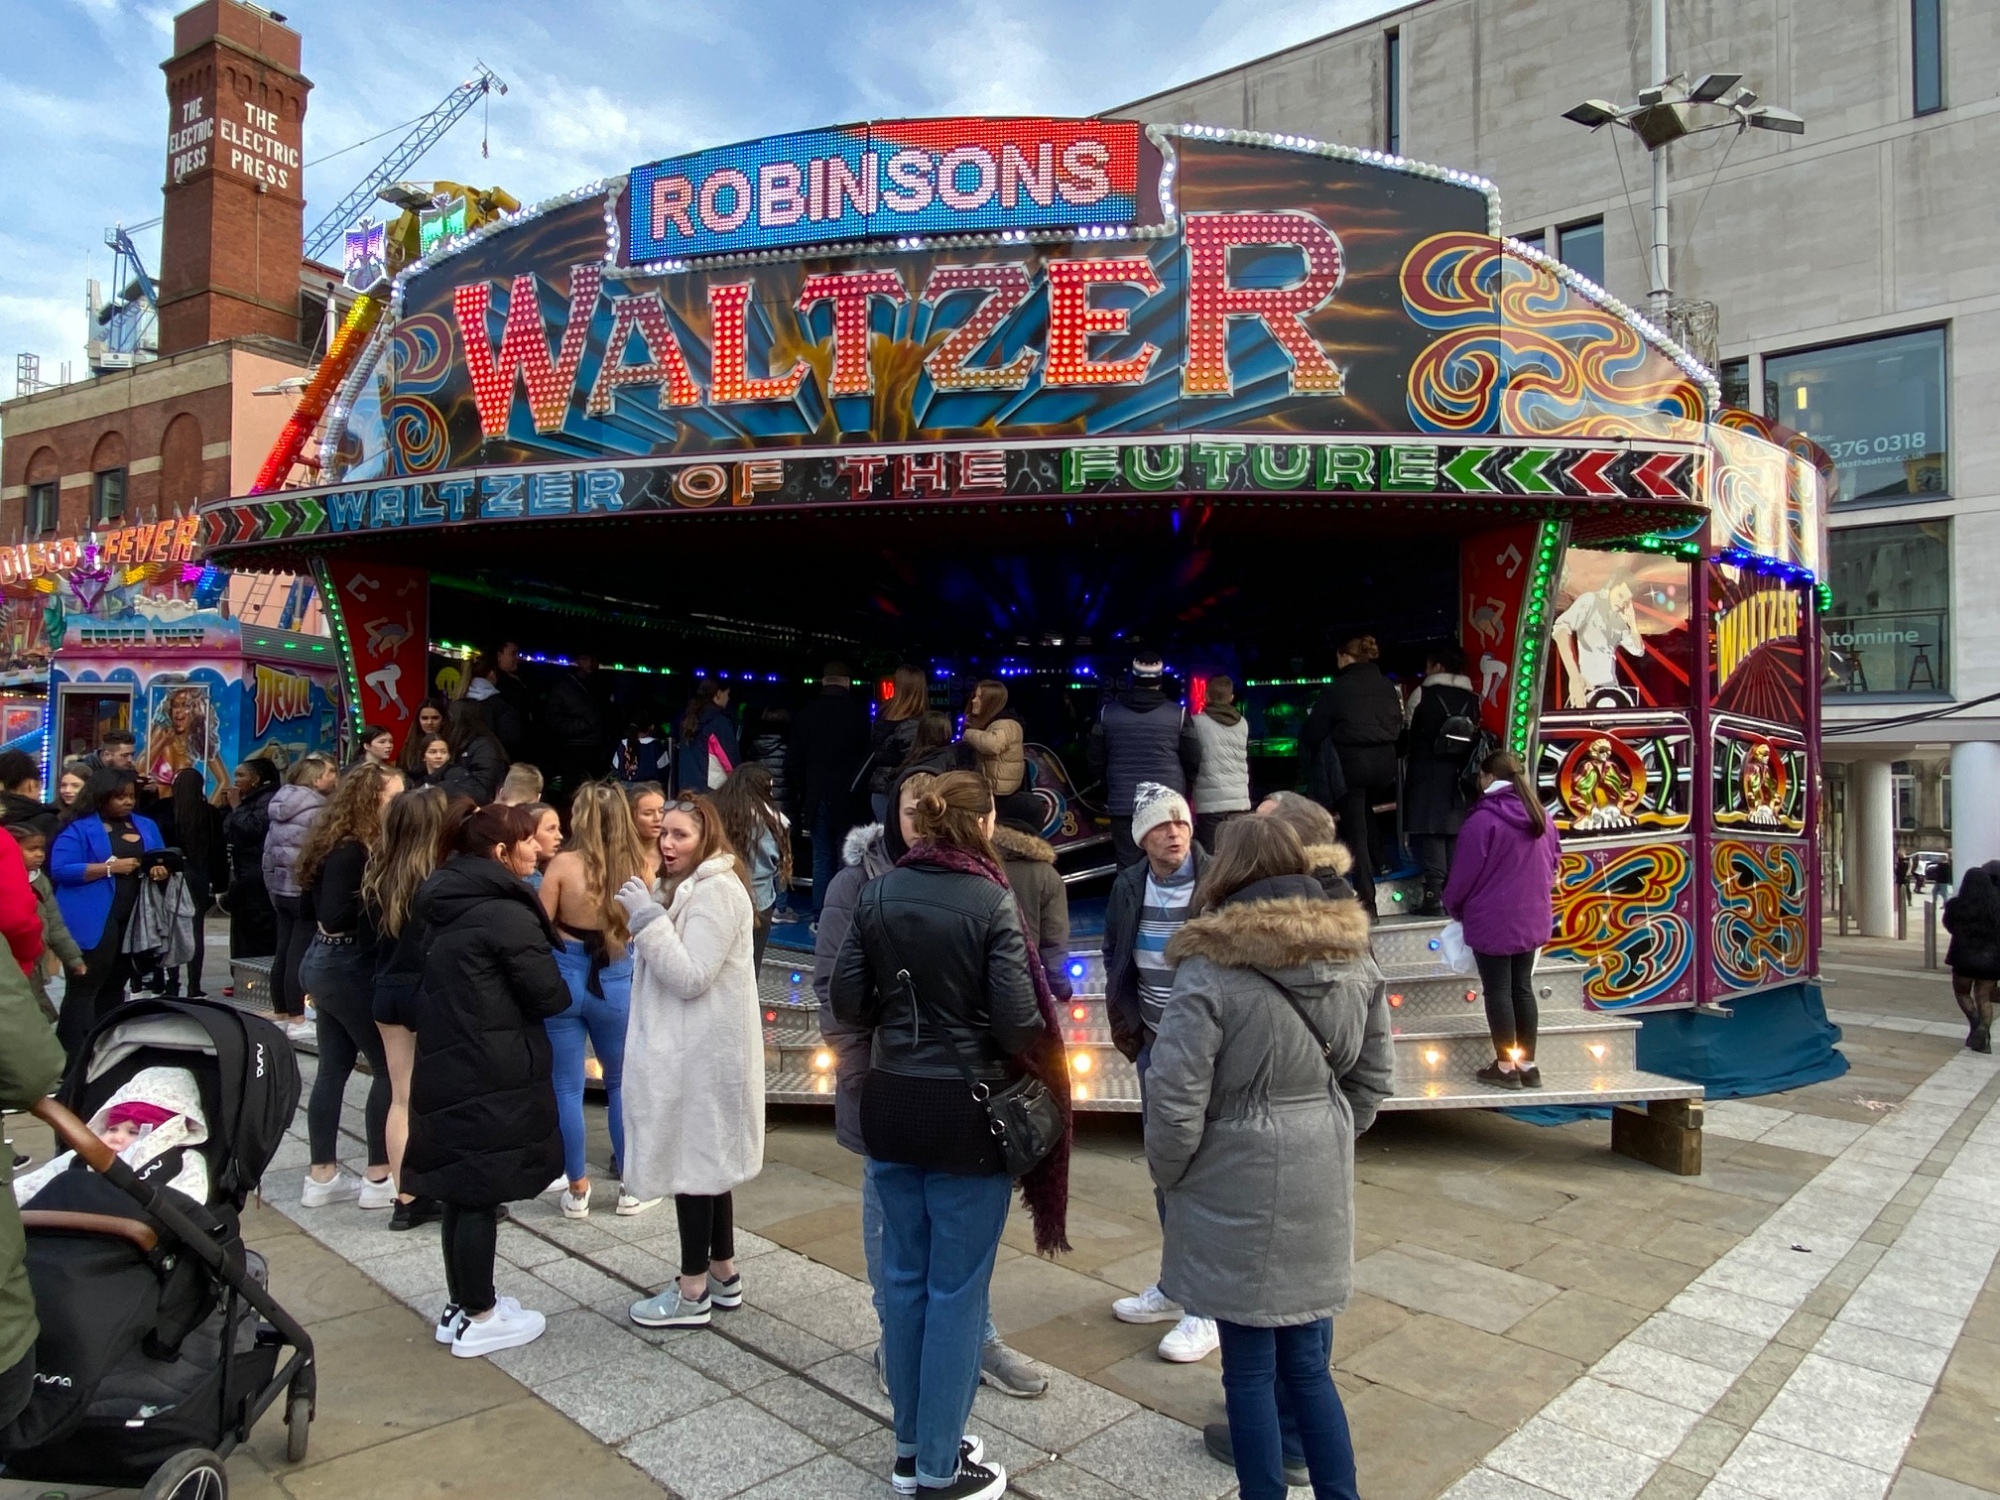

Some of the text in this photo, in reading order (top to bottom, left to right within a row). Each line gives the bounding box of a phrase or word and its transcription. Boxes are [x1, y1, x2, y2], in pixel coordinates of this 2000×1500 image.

[183, 97, 203, 124] THE
[244, 101, 279, 135] THE
[169, 117, 214, 154] ELECTRIC
[220, 117, 299, 168] ELECTRIC
[173, 145, 207, 178] PRESS
[231, 149, 288, 189] PRESS
[650, 138, 1111, 240] ROBINSONS
[451, 207, 1348, 440] WALTZER
[1829, 431, 1926, 459] 376 0318
[325, 441, 1440, 533] WALTZER OF THE FUTURE
[0, 514, 200, 585] DISCO FEVER
[1717, 589, 1799, 694] WALTZER
[1830, 627, 1920, 647] tomime
[256, 1042, 264, 1078] nuna
